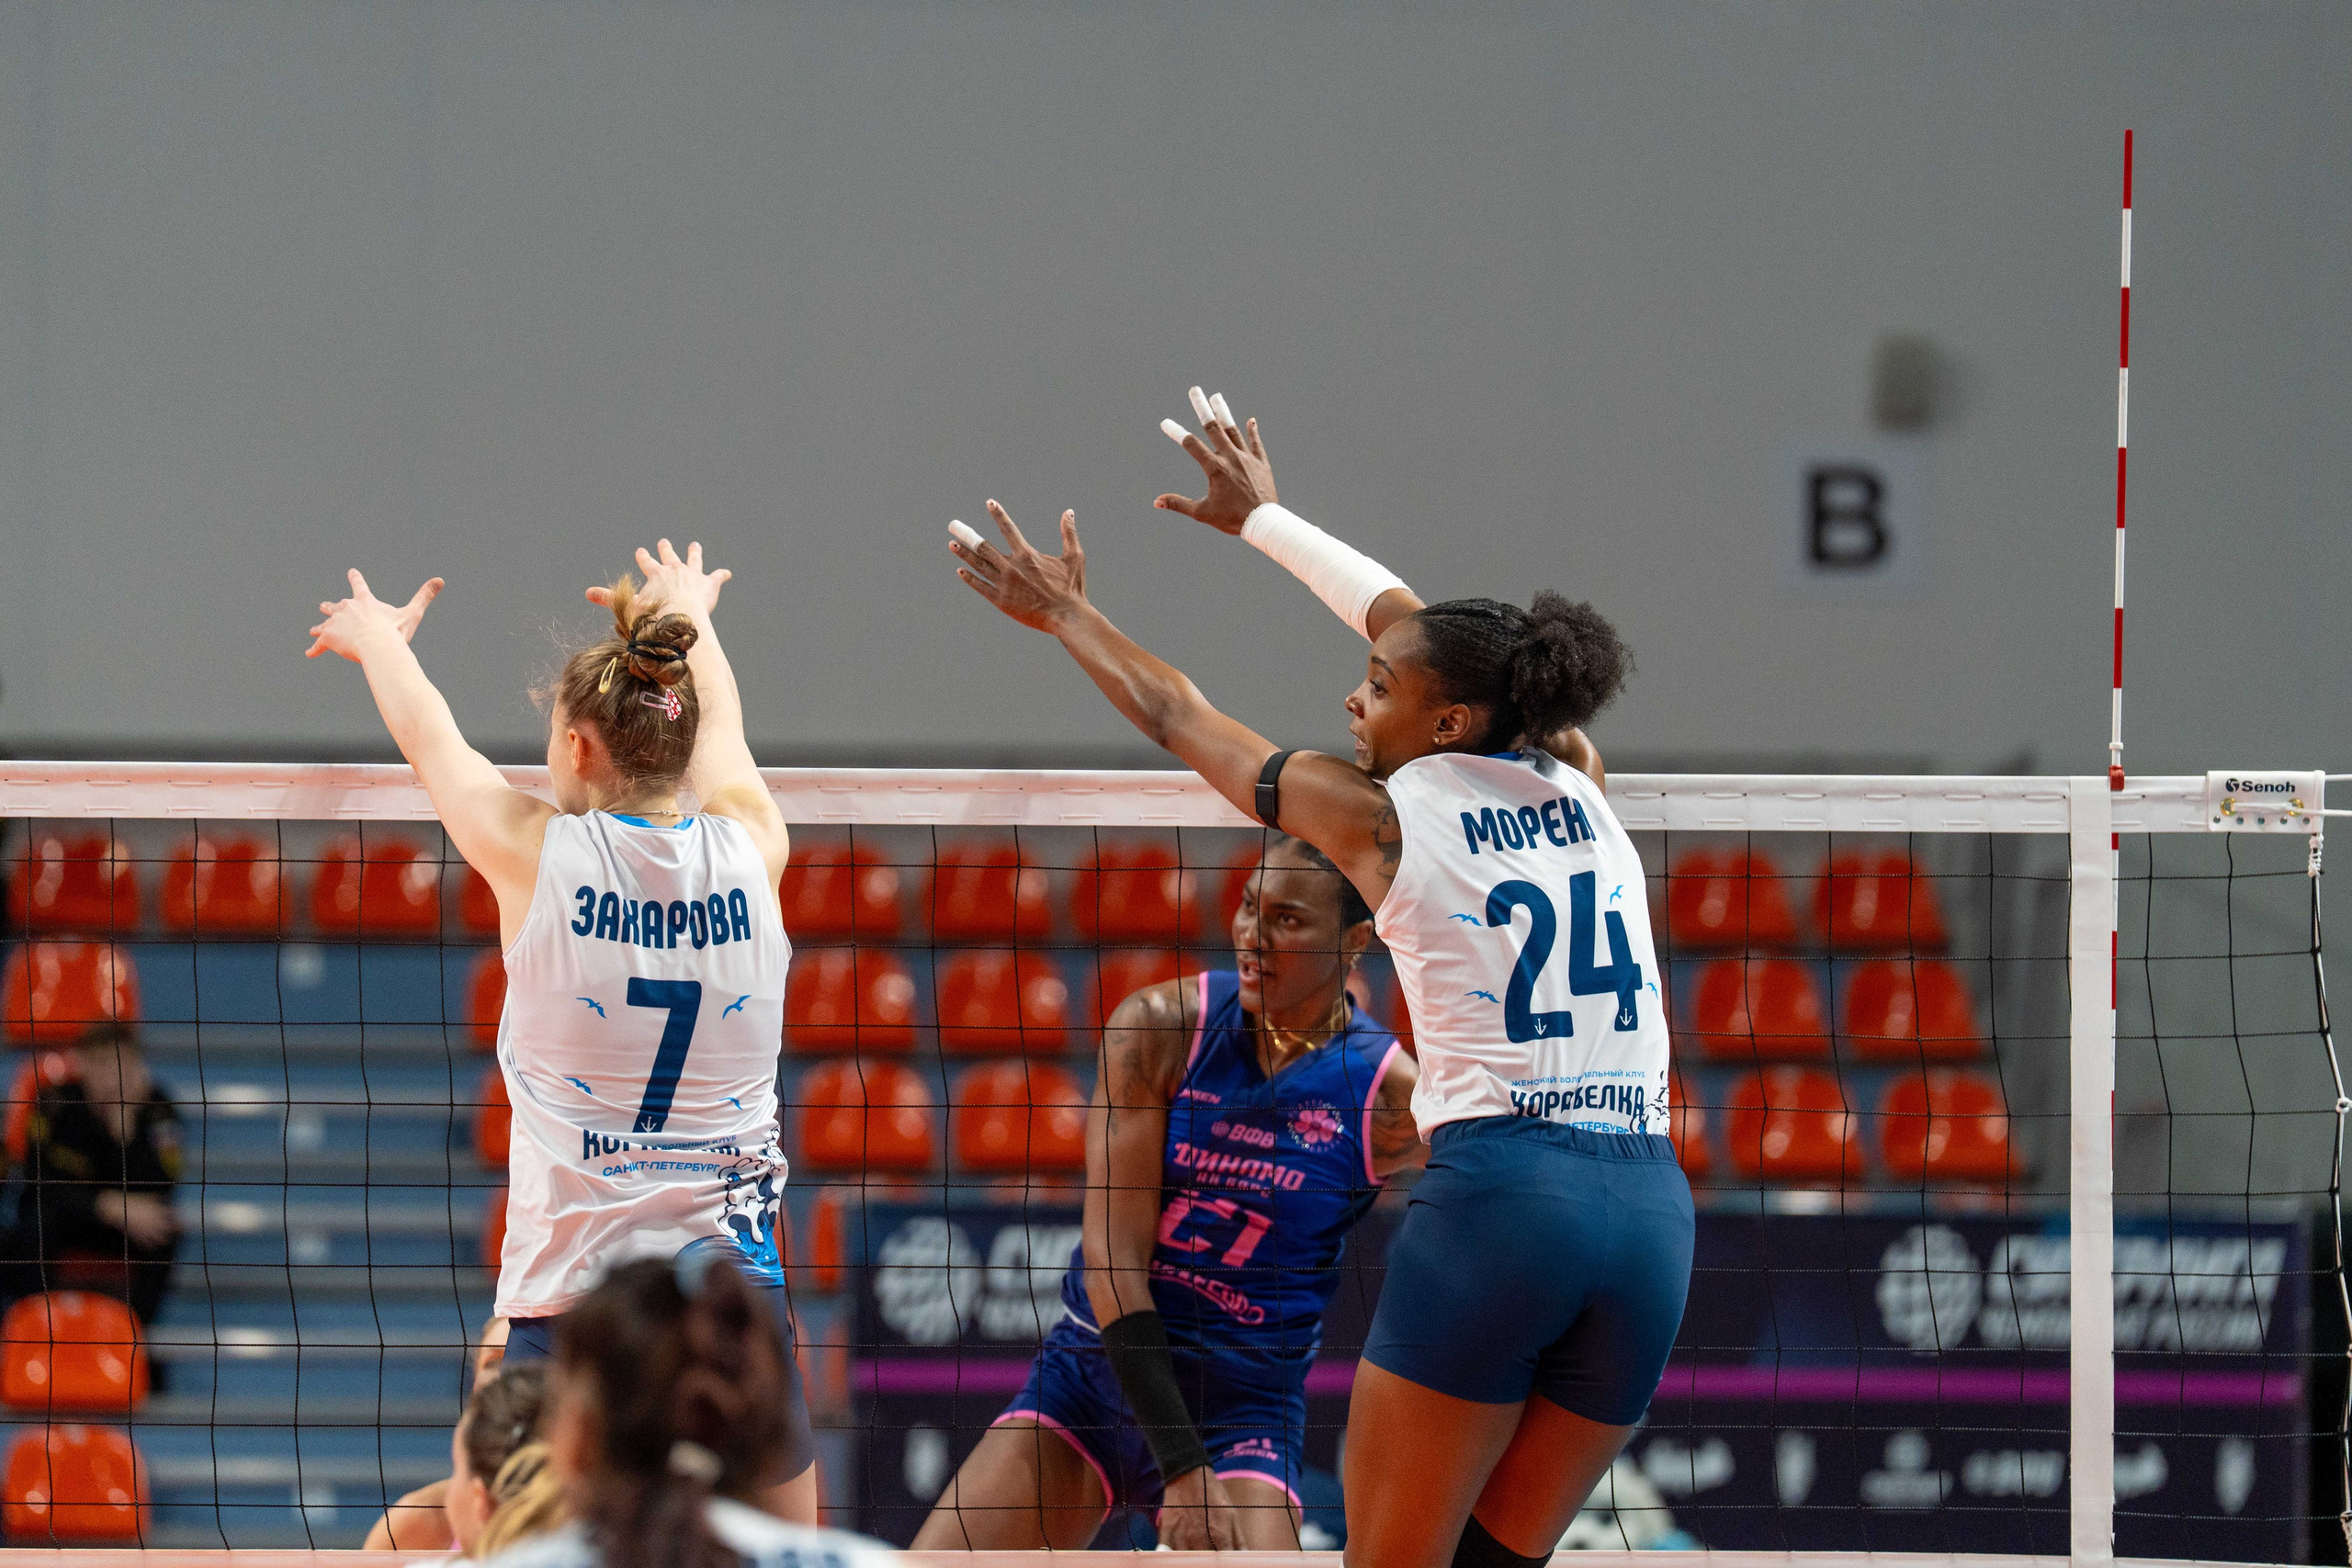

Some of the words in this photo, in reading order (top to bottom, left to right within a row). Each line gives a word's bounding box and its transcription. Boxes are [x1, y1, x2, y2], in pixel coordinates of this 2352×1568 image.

[2242, 780, 2296, 793] Senoh
[1460, 795, 1597, 855] МОРЕН
[571, 885, 752, 950] ЗАХАРОВА
[1486, 870, 1643, 1043] 24
[627, 976, 702, 1133] 7
[1511, 1075, 1557, 1087] ЖЕНСКИЙ
[1625, 1070, 1645, 1078] КЛУБ
[712, 1134, 737, 1145] КЛУБ
[1227, 1123, 1276, 1148] ВФВ
[603, 1160, 720, 1177] САНКТ-ПЕТЕРБУРГ
[1173, 1142, 1306, 1190] ДИНАМО
